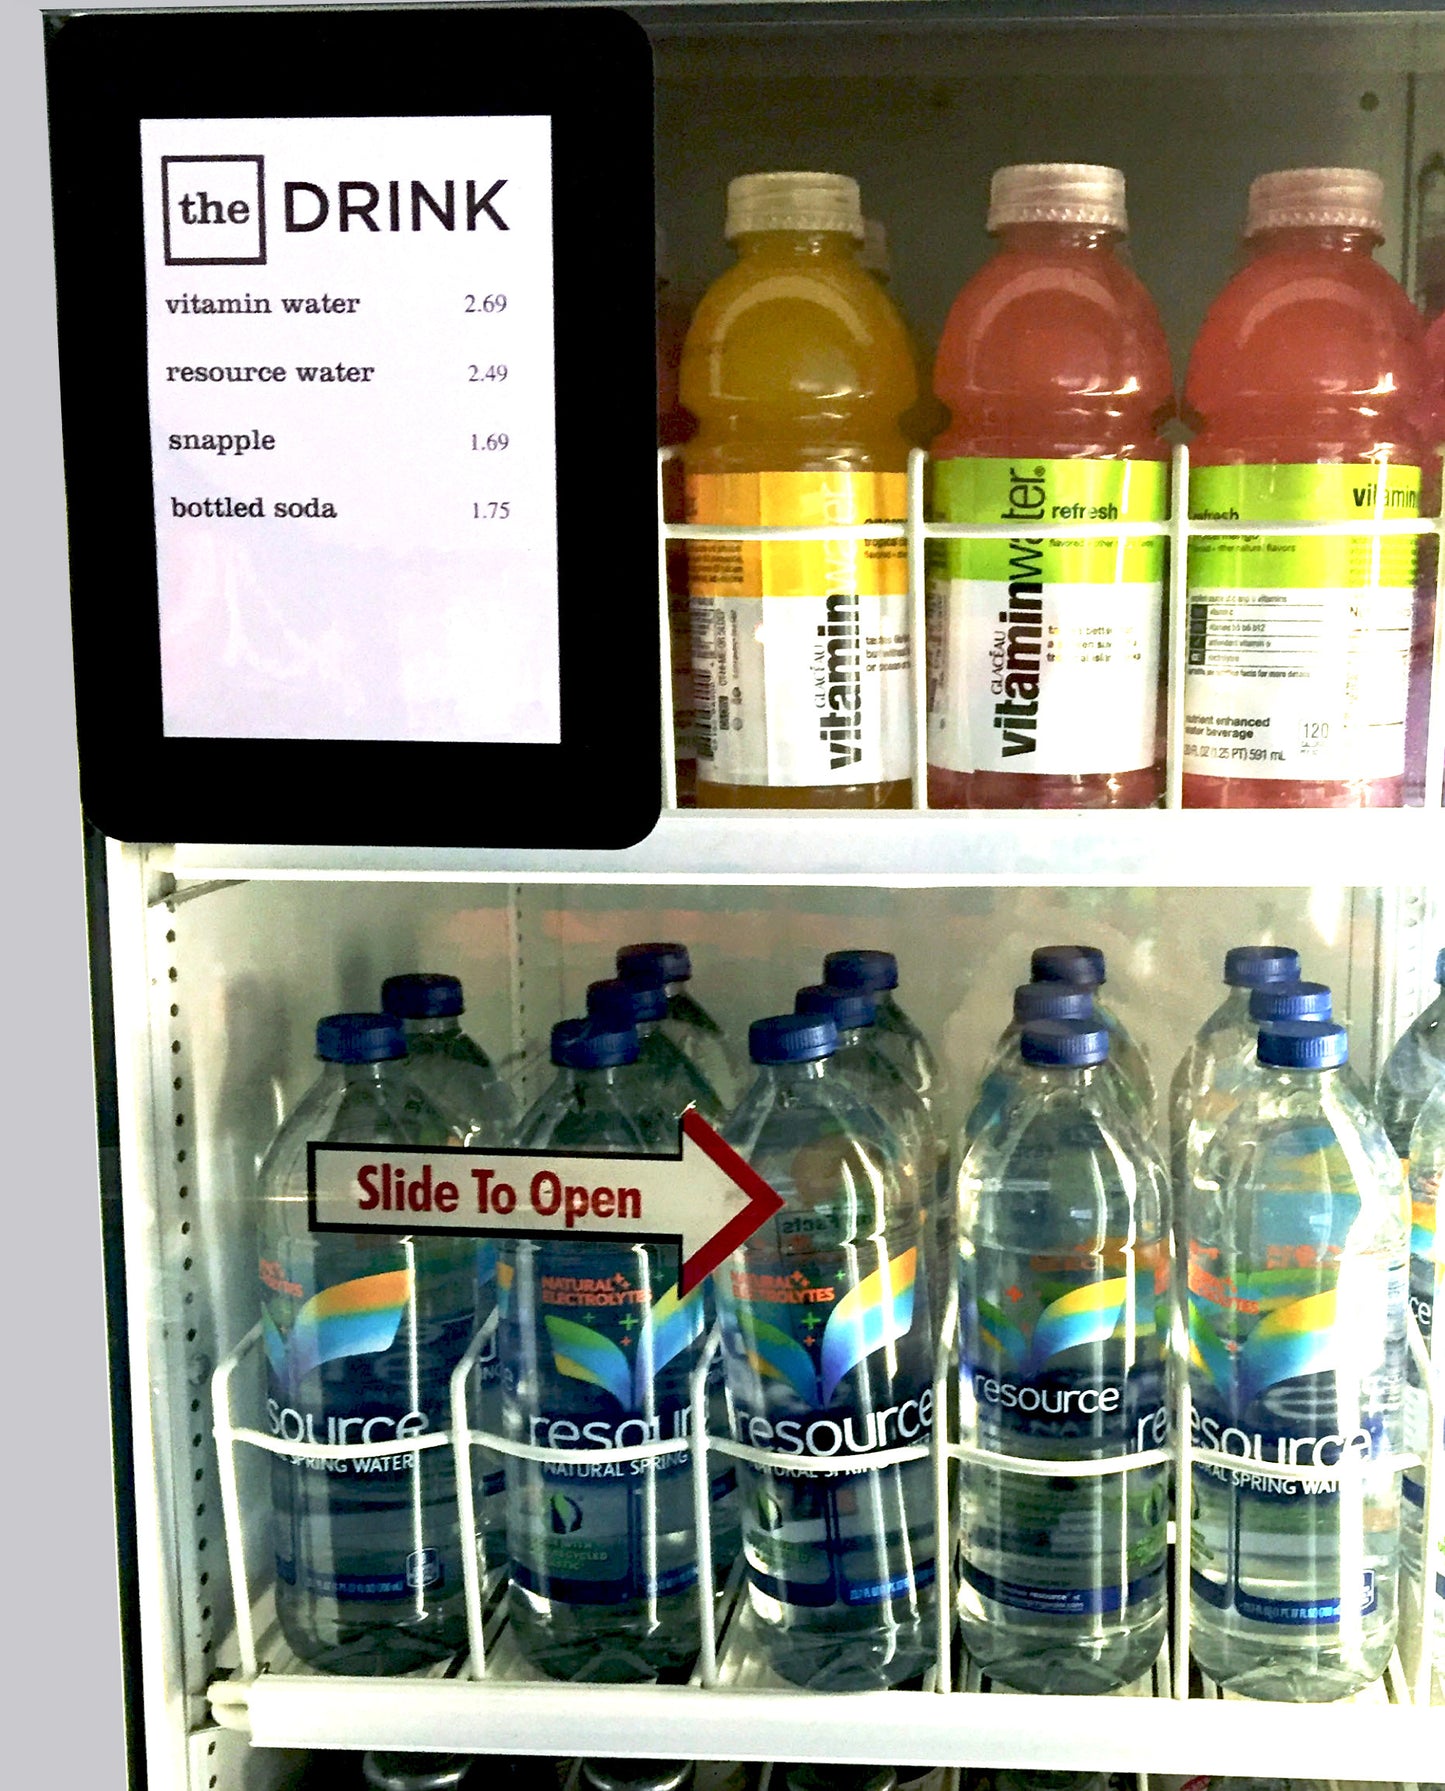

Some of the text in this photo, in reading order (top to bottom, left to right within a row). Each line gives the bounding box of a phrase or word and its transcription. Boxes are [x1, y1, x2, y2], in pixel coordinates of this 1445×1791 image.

[179, 179, 511, 232] the DRINK
[165, 293, 508, 314] vitamin water 2.69
[166, 364, 509, 383] resource water 2.49
[168, 430, 510, 456] snapple 1.69
[171, 497, 511, 520] bottled soda 1.75
[1052, 503, 1118, 519] refresh
[1206, 727, 1254, 740] beverage
[1215, 717, 1271, 728] enhanced
[1303, 722, 1329, 739] 120
[1249, 748, 1267, 761] 591
[357, 1163, 642, 1228] Slide To Open
[974, 1373, 1121, 1415] resource
[736, 1388, 933, 1457] resource
[353, 1454, 416, 1474] WATER
[630, 1451, 688, 1476] SPRING
[1231, 1470, 1297, 1495] SPRING
